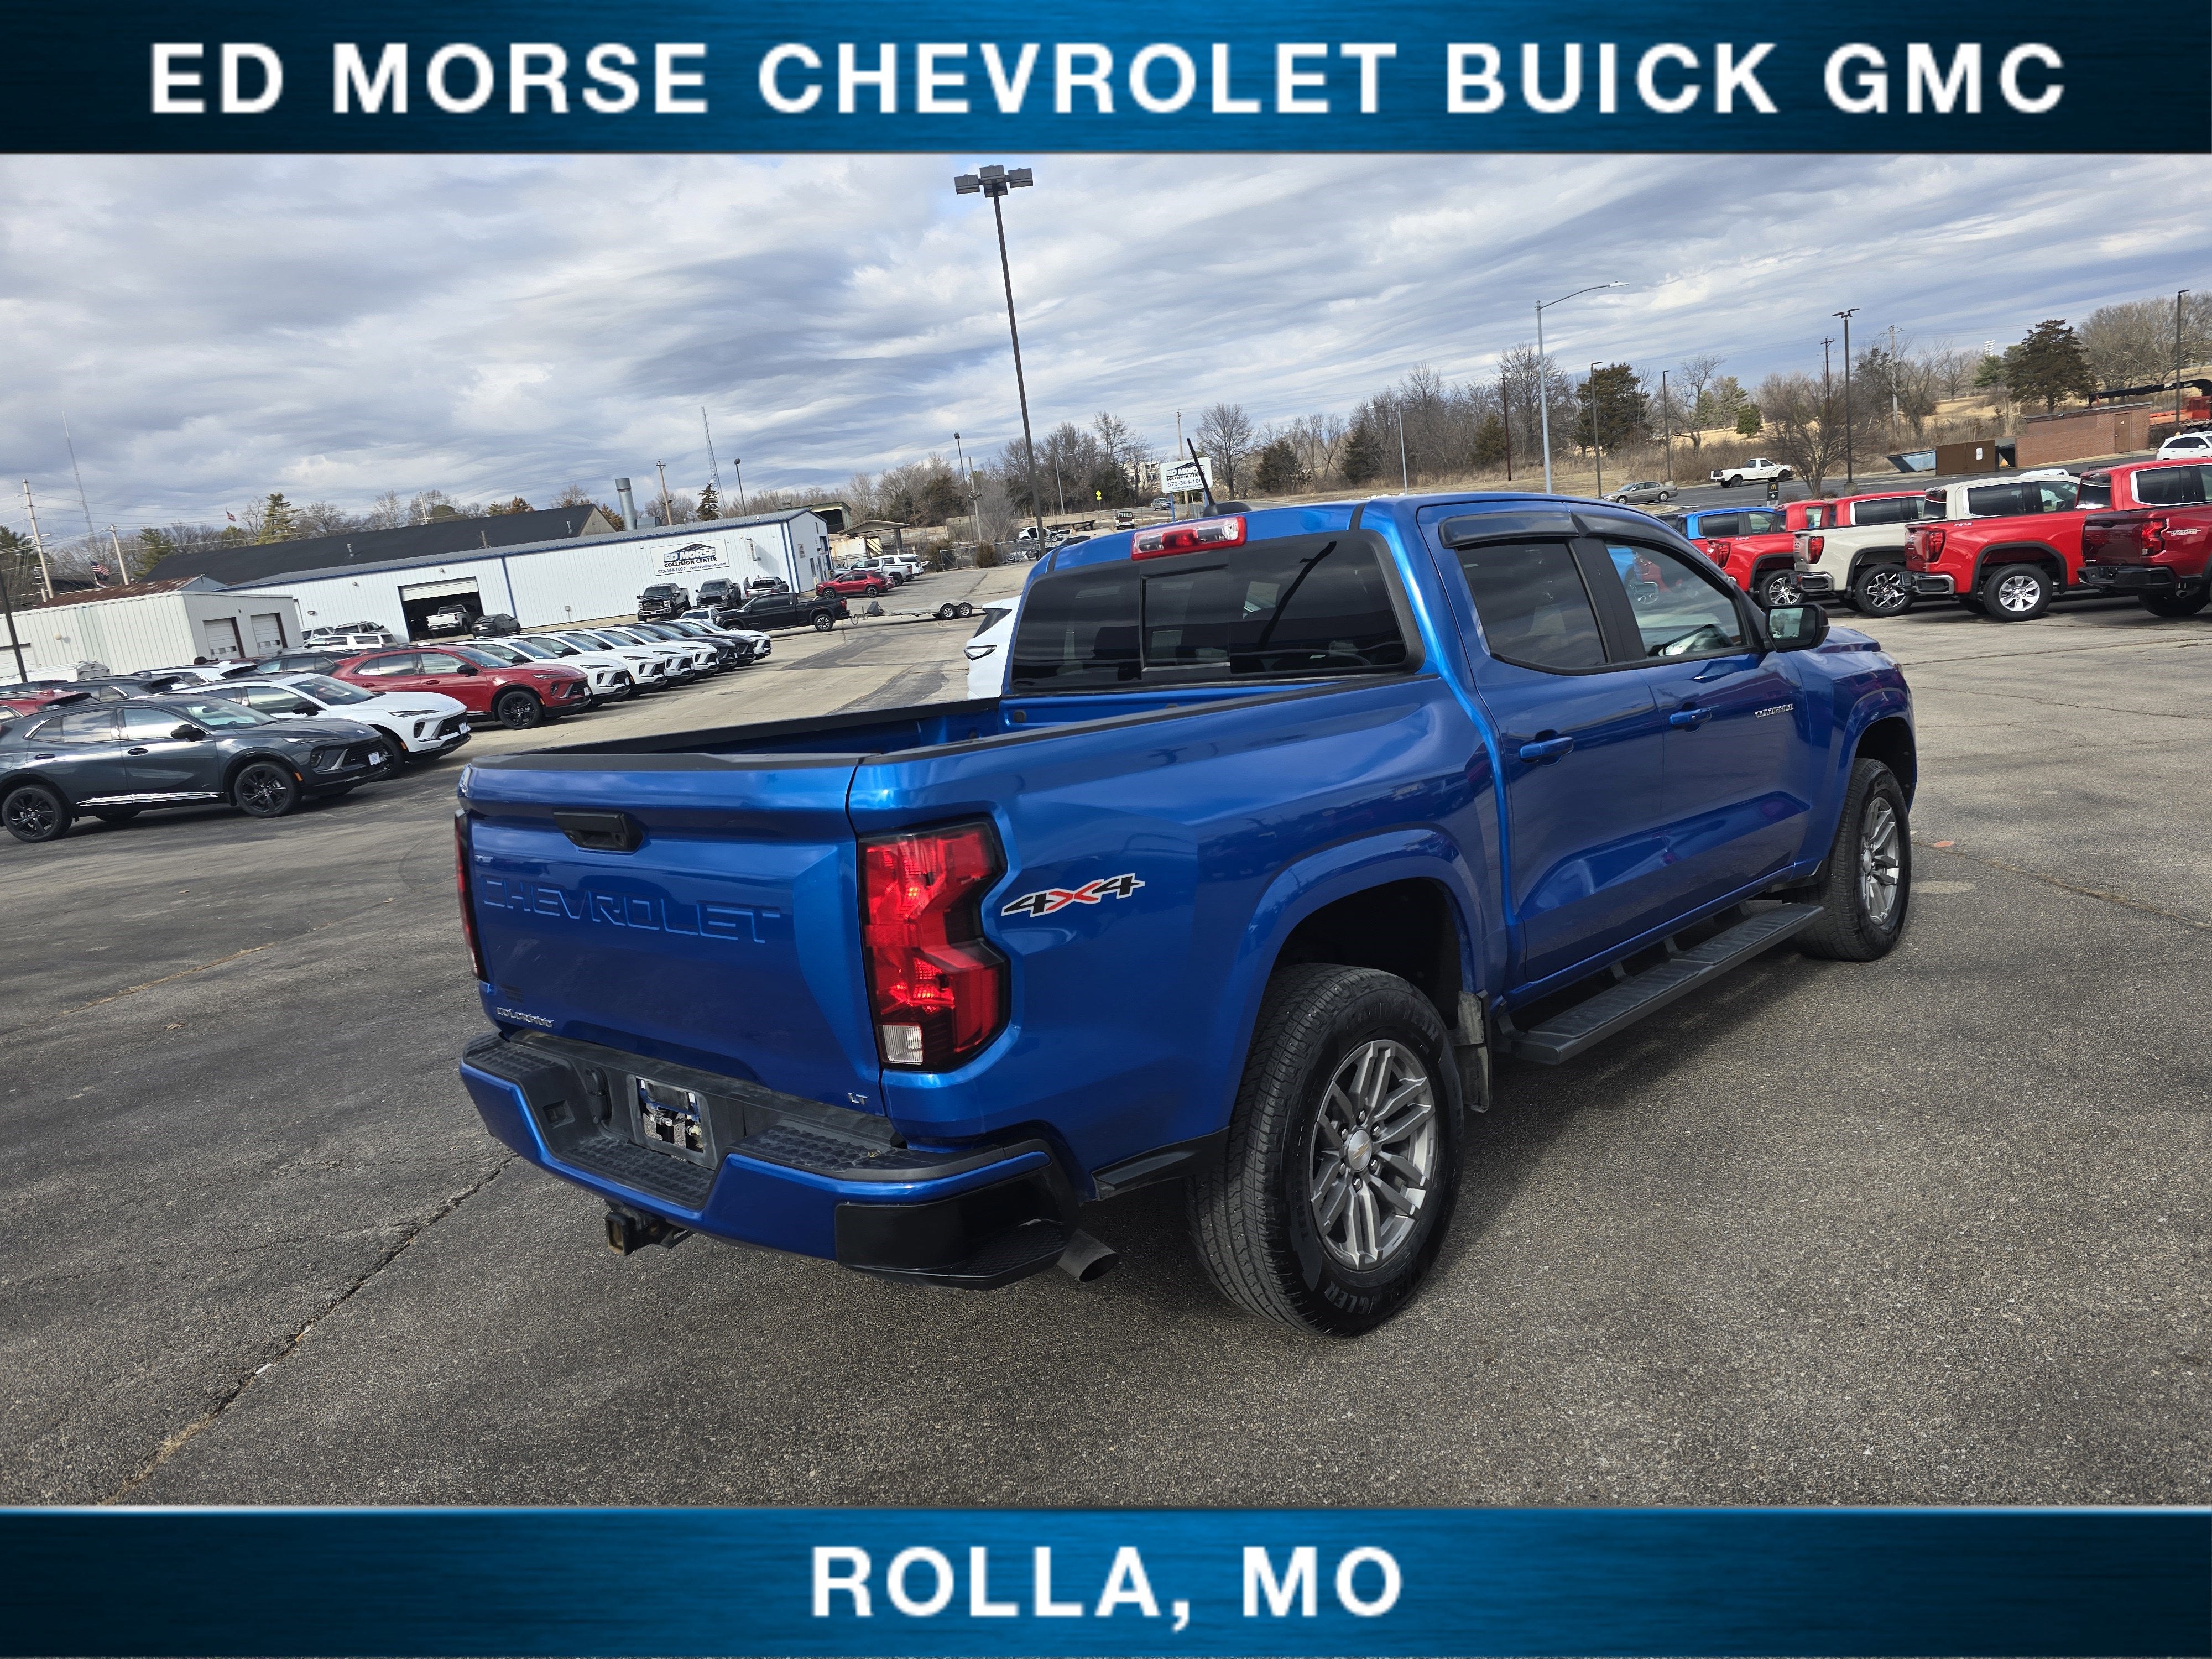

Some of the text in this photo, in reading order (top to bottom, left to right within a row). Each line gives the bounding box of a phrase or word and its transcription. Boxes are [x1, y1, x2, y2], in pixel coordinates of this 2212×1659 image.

[1167, 478, 1203, 487] 573-364-100
[664, 547, 716, 562] ED MORSE
[481, 873, 781, 945] CHEVROLET
[848, 1092, 868, 1105] LT
